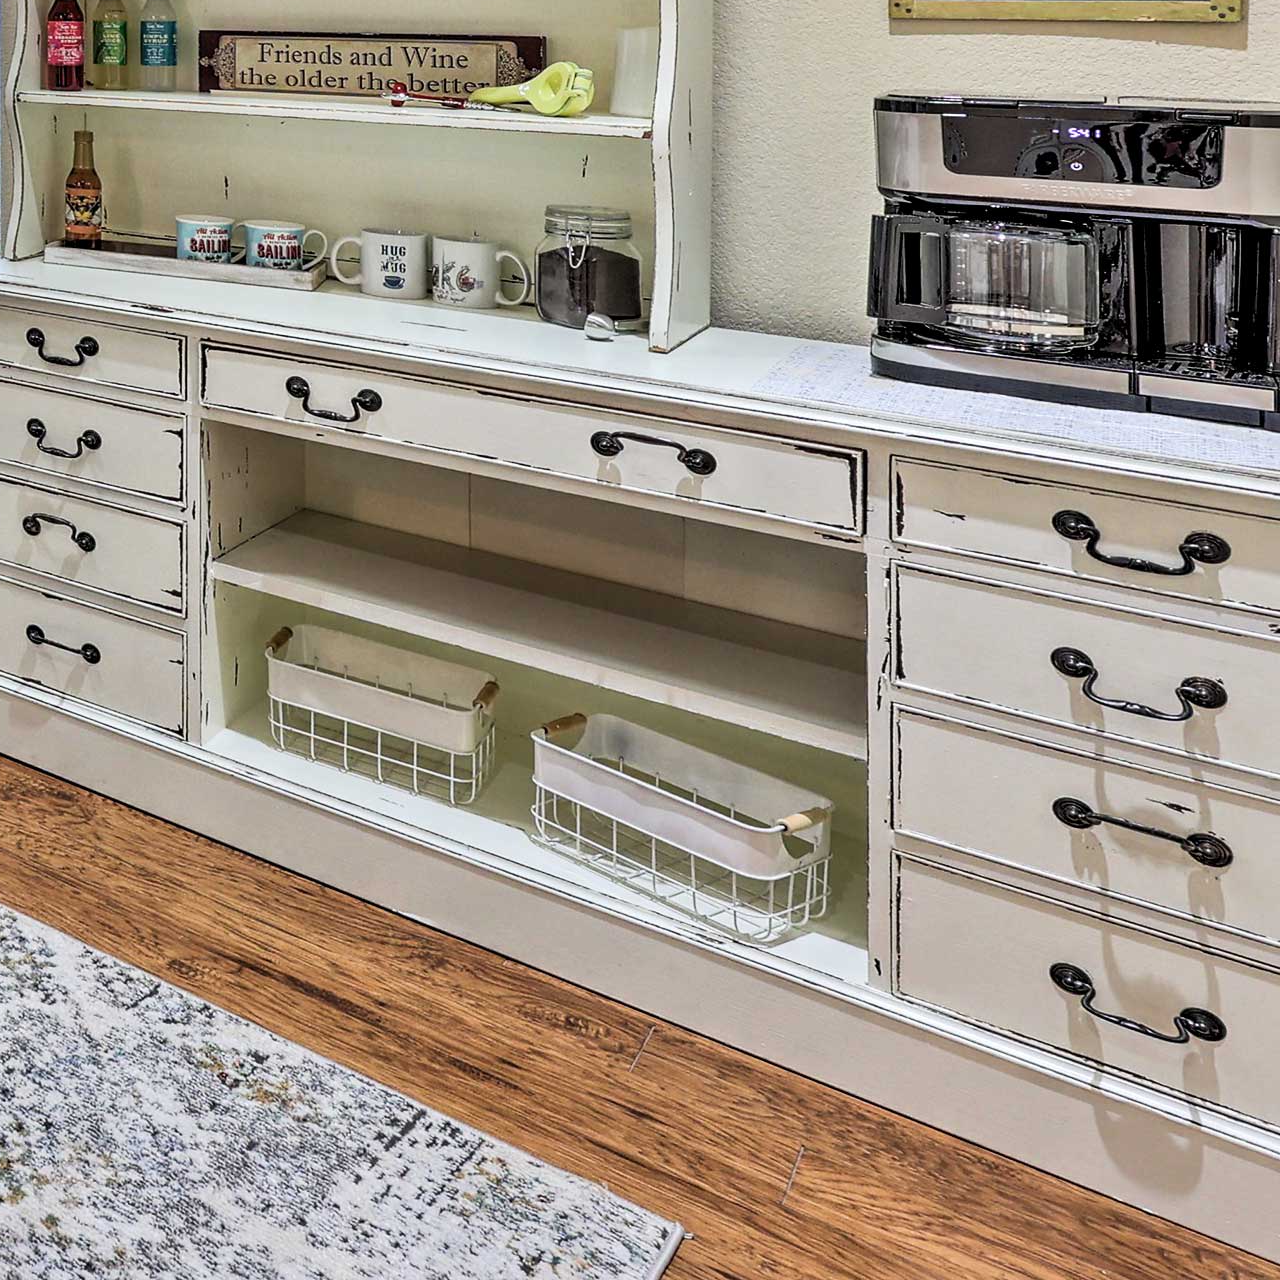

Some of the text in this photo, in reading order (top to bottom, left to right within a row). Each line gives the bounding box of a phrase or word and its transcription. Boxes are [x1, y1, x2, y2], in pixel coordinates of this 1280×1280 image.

[256, 42, 469, 70] Friends and Wine
[239, 68, 278, 87] the
[285, 69, 350, 90] older
[381, 243, 407, 257] HUG
[380, 260, 407, 274] MUG
